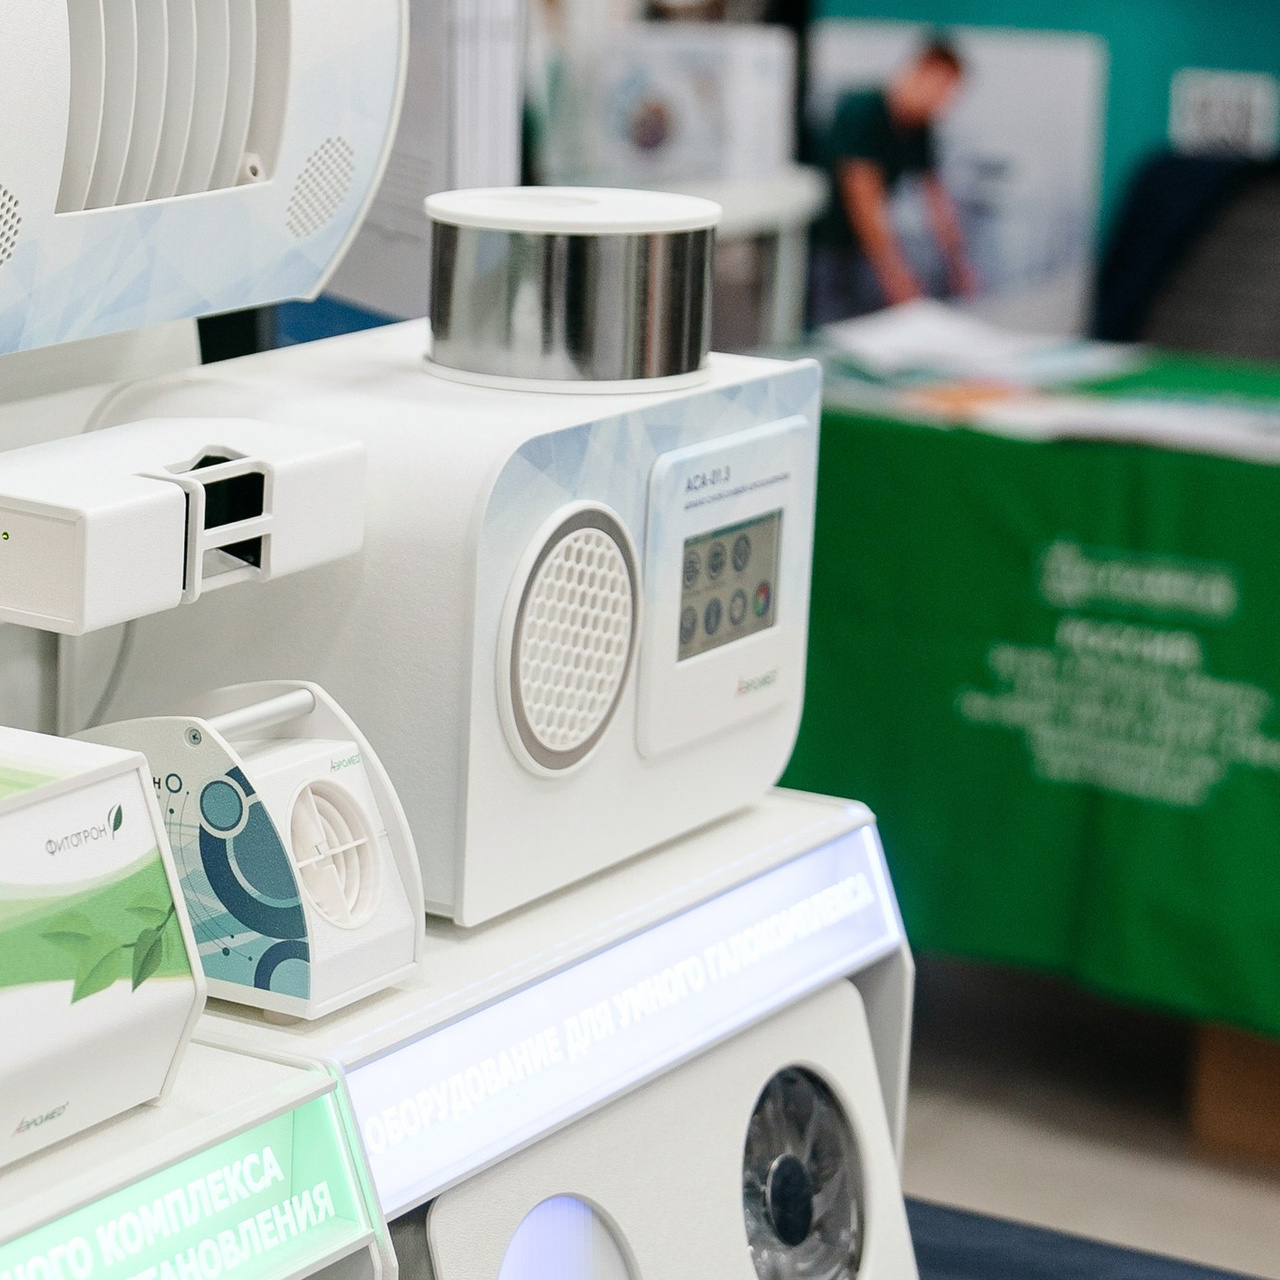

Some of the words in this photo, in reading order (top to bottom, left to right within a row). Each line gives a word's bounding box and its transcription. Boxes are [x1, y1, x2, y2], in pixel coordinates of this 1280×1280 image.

[45, 823, 107, 856] ФИТОТРОН
[364, 1028, 564, 1155] ОБОРУДОВАНИЕ
[564, 1004, 615, 1062] ДЛЯ
[612, 956, 704, 1026] УМНОГО
[100, 1145, 288, 1269] КОМПЛЕКСА
